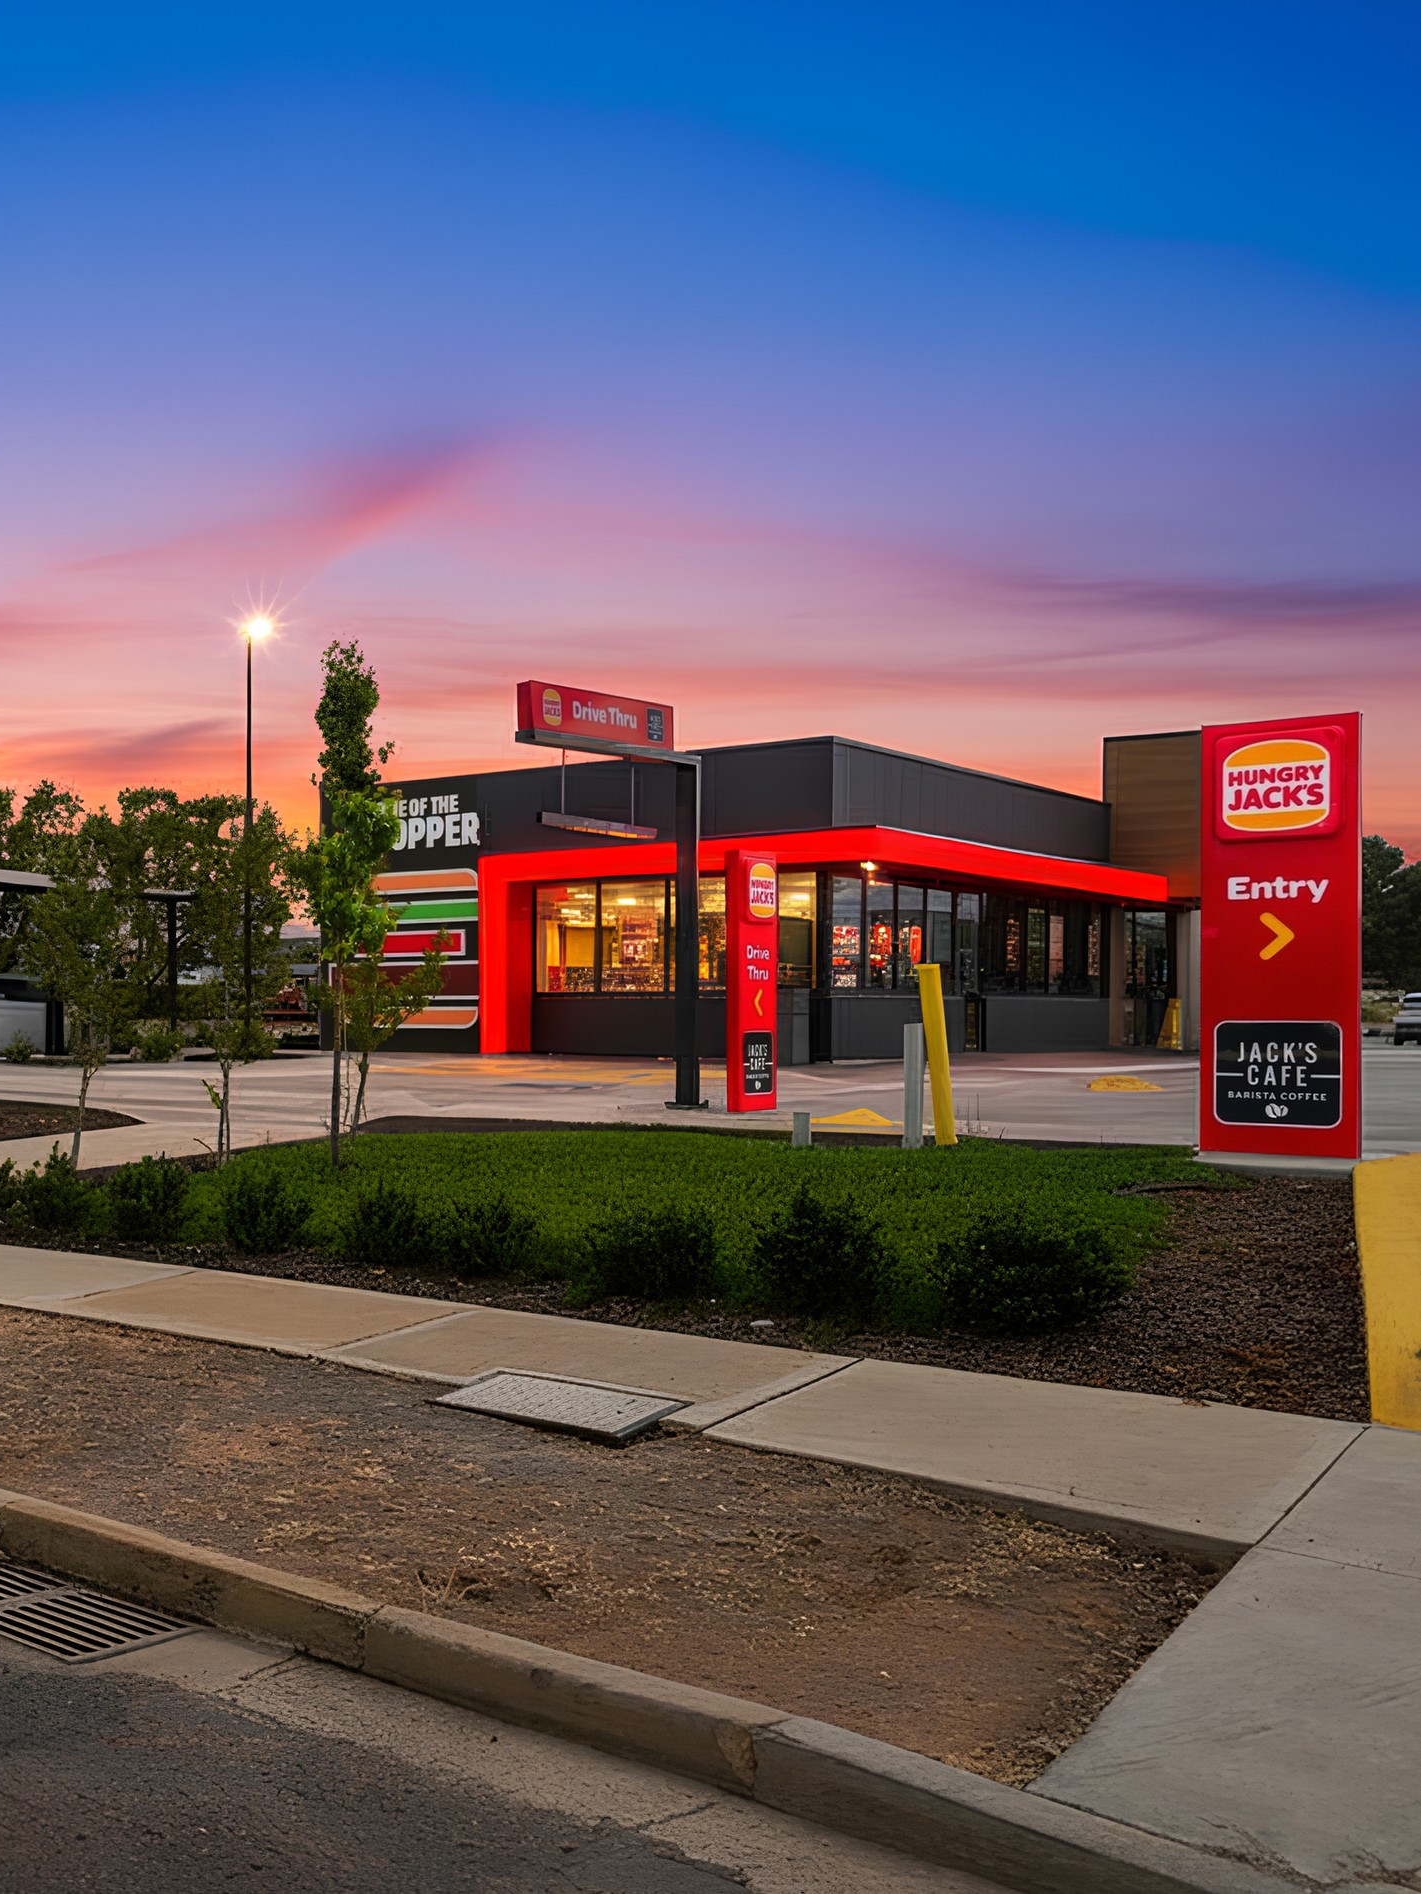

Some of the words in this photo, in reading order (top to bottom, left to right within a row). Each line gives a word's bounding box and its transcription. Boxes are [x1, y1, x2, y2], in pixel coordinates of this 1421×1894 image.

[572, 700, 607, 724] Drive
[608, 706, 638, 729] Thru
[1228, 764, 1324, 787] HUNGRY
[408, 797, 428, 817] OF
[430, 794, 459, 815] THE
[1228, 783, 1324, 811] JACK'S
[392, 812, 480, 851] OPPER
[1227, 876, 1329, 903] Entry
[747, 945, 770, 960] Drive
[747, 965, 769, 980] Thru
[1237, 1042, 1318, 1063] JACK'S
[1247, 1064, 1307, 1087] CAFE
[1228, 1090, 1277, 1100] BARISTA
[1280, 1092, 1327, 1101] COFFEE
